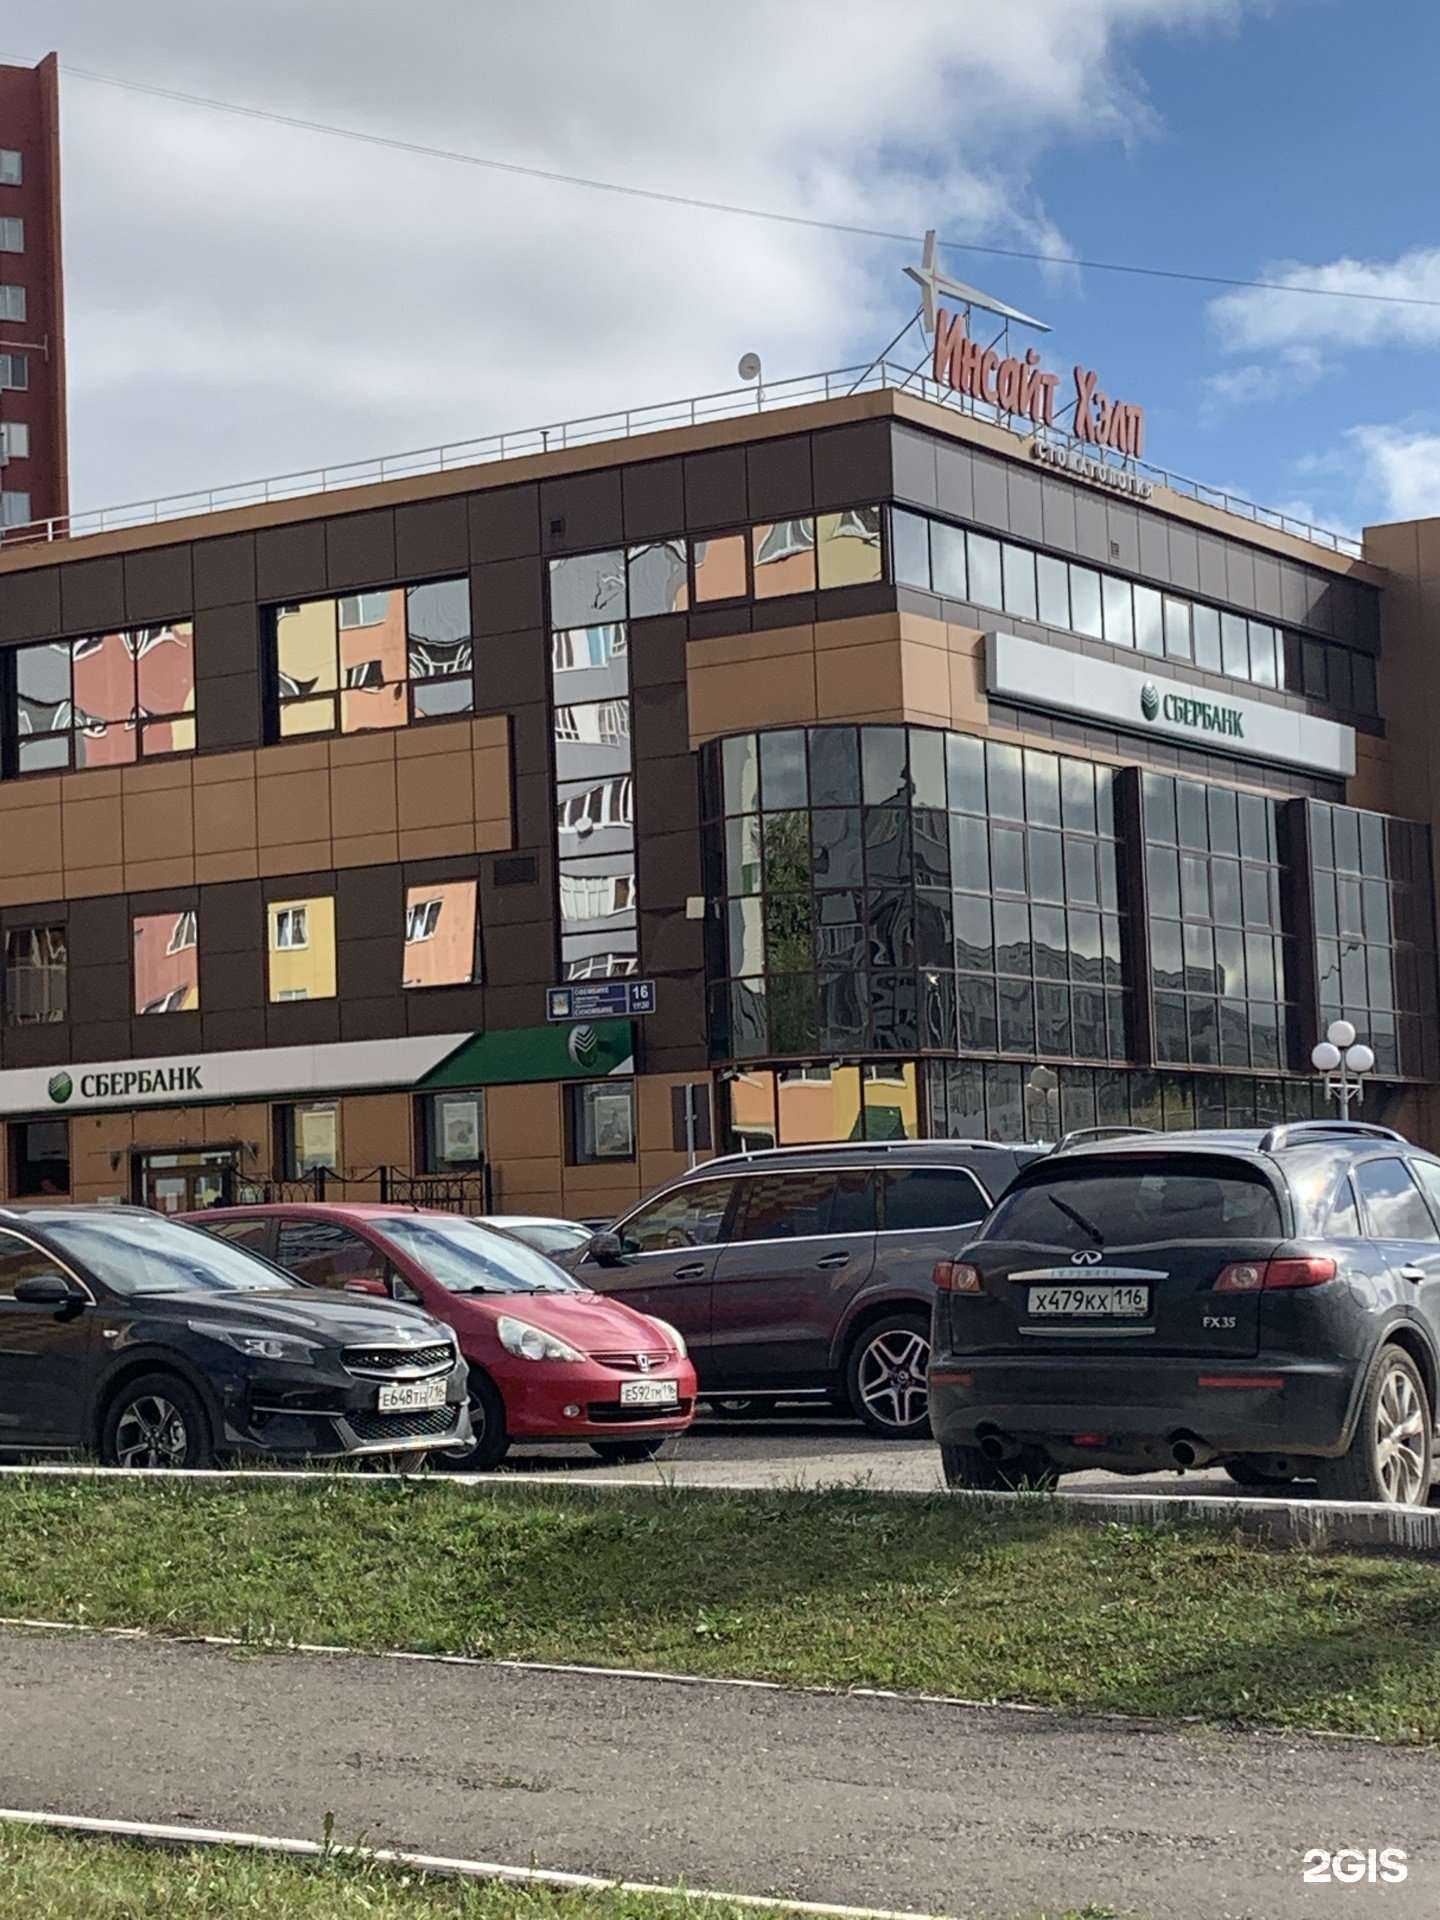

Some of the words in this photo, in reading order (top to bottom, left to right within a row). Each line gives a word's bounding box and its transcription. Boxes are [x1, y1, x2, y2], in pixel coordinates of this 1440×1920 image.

[933, 308, 1060, 427] Инсайт
[1073, 362, 1143, 459] Хэлп
[1163, 693, 1244, 739] СБЕРБАНК
[632, 984, 649, 999] 16
[81, 1066, 203, 1098] СБЕРБАНК
